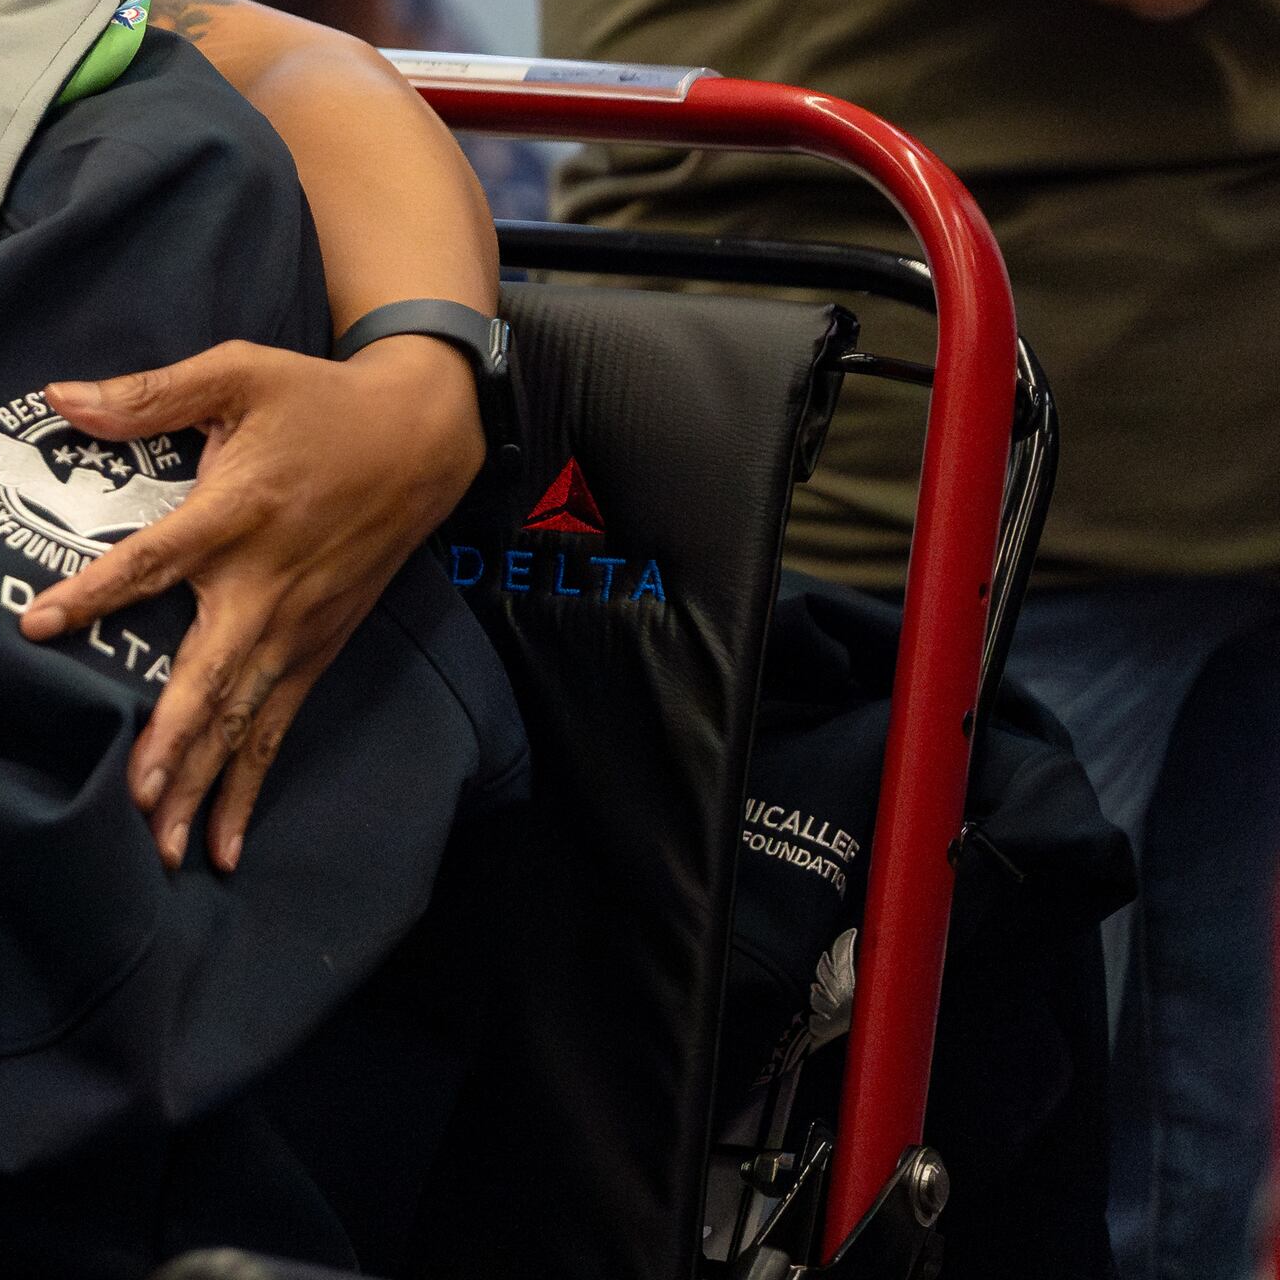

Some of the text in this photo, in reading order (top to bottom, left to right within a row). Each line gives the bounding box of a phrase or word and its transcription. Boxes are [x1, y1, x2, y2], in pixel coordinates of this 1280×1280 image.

[450, 544, 668, 604] DELTA
[0, 575, 173, 683] DLTA
[744, 797, 861, 865] ICALLEF
